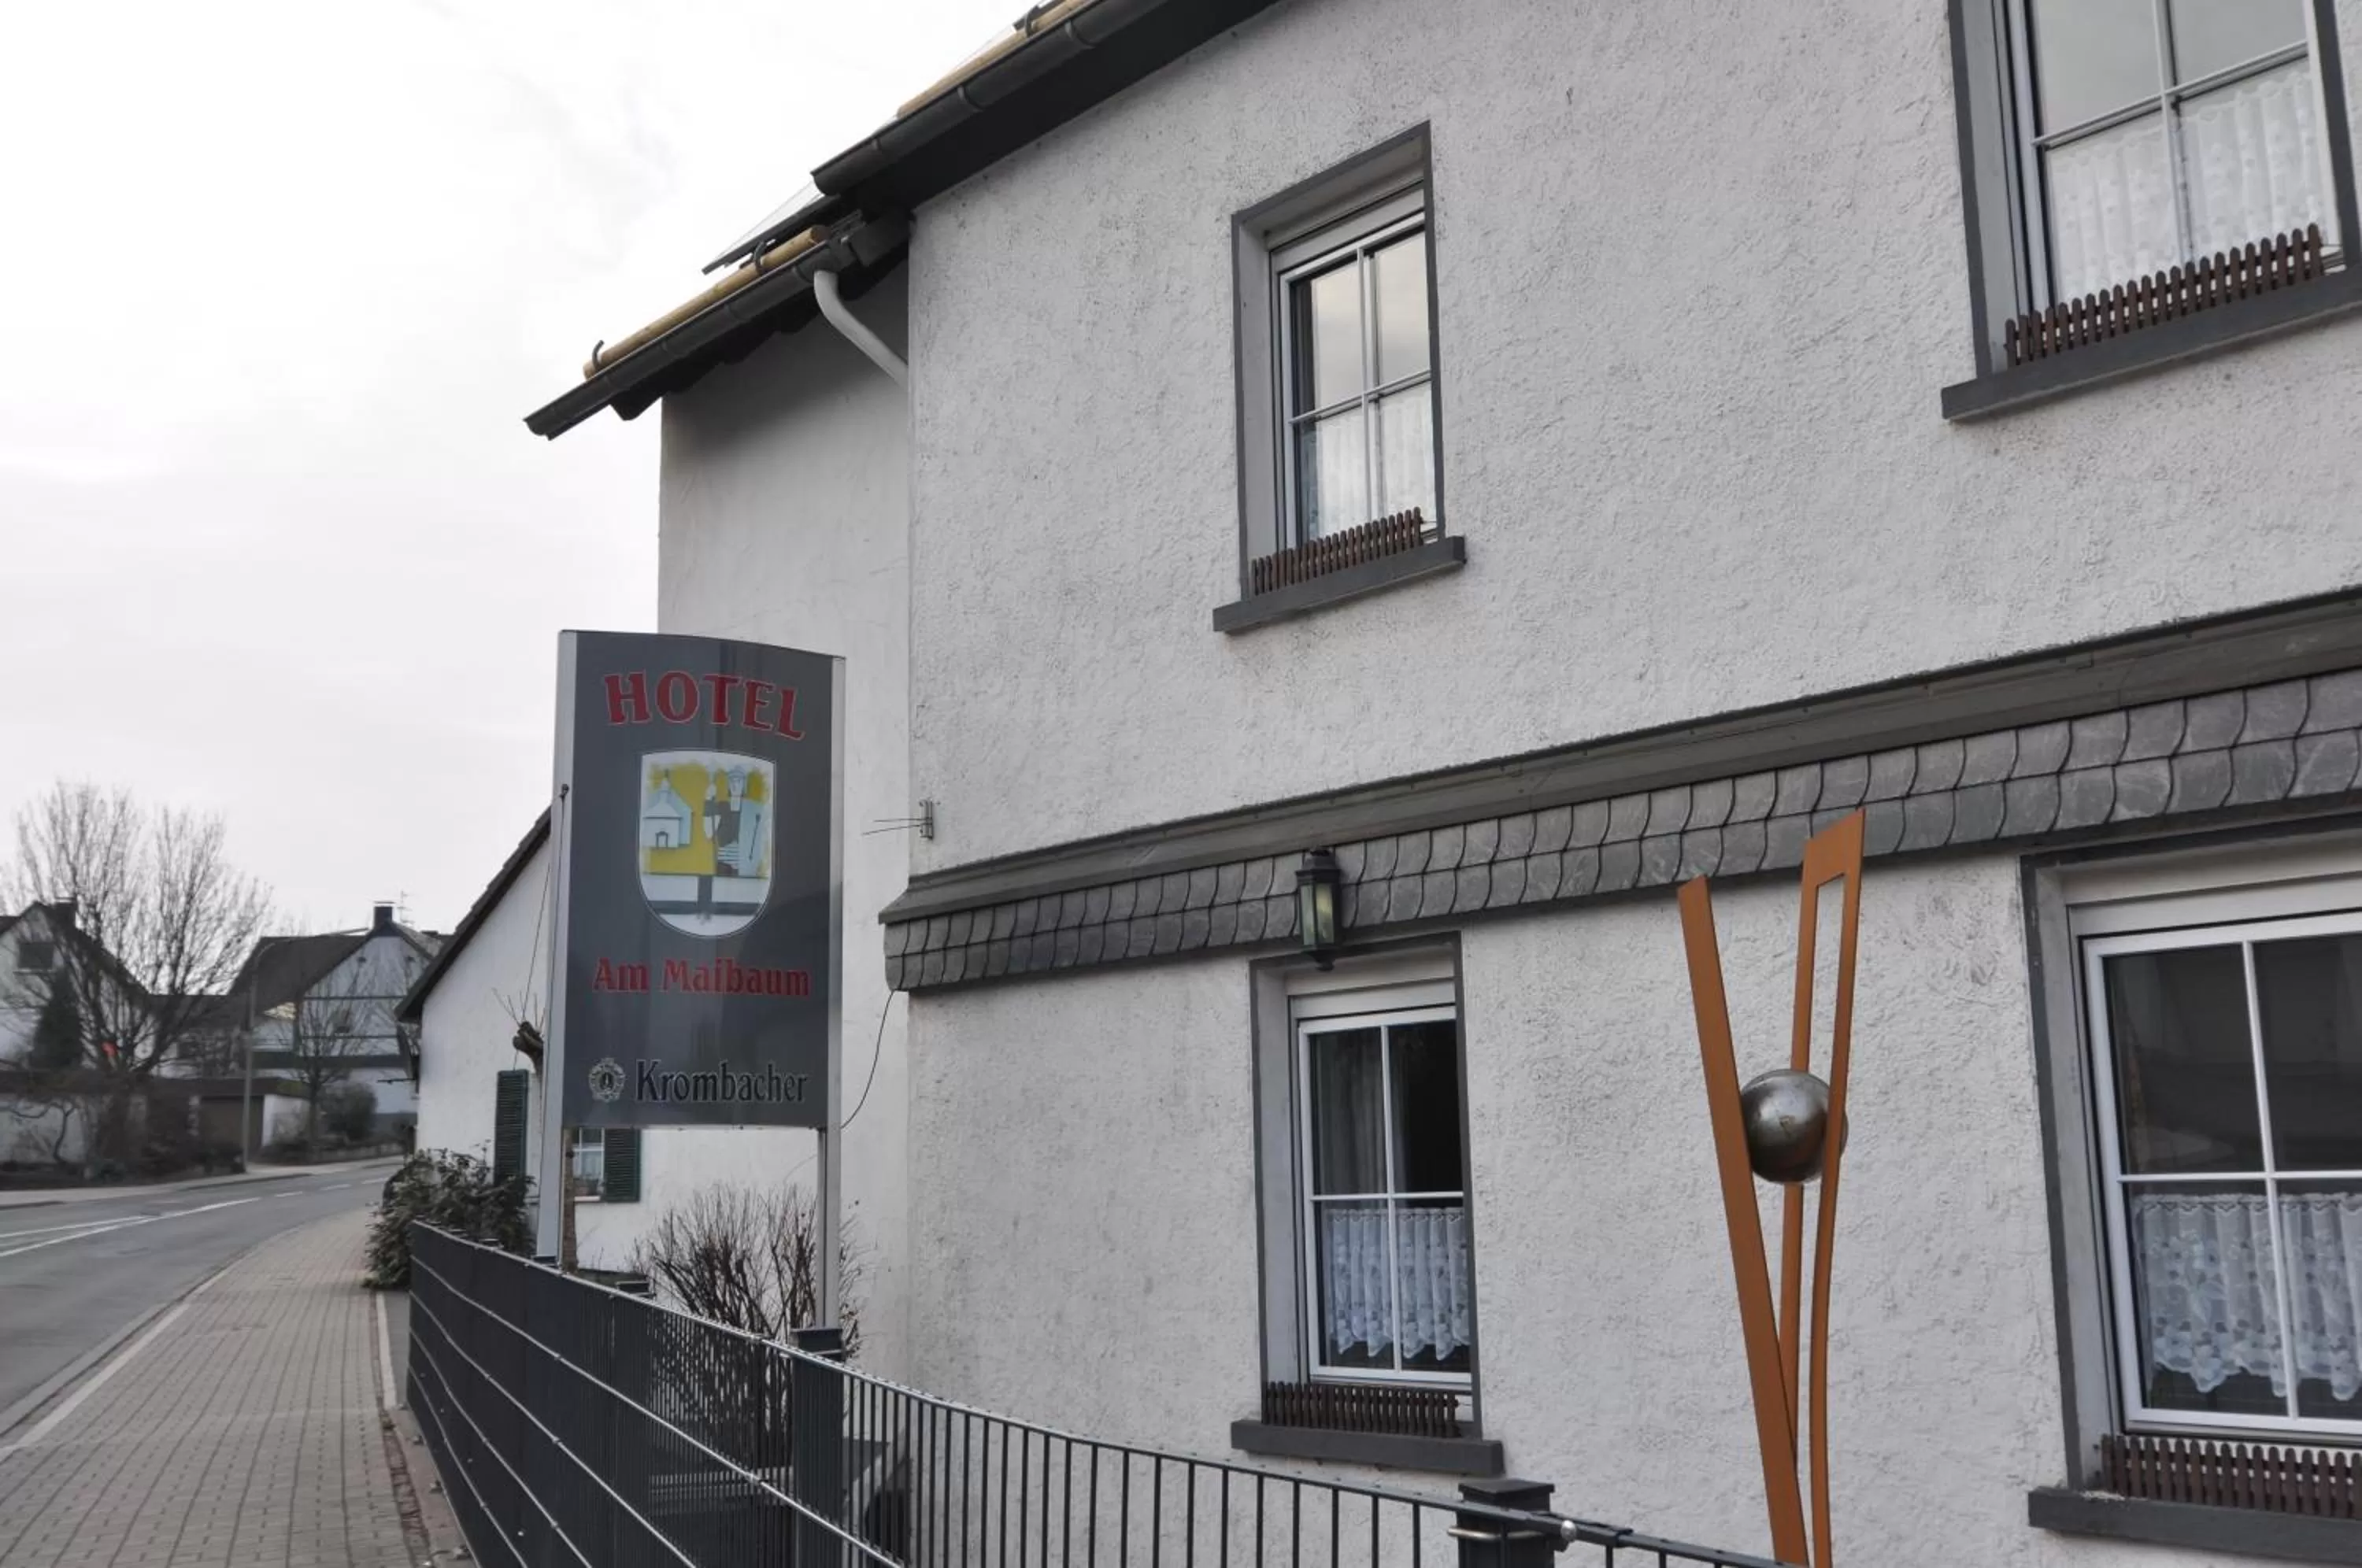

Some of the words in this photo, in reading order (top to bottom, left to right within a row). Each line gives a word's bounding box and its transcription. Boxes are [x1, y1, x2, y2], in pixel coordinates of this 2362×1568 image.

[604, 670, 805, 741] HOTEL
[592, 956, 650, 994] Am
[661, 956, 811, 998] Maibaum
[636, 1060, 809, 1102] Krombacher
